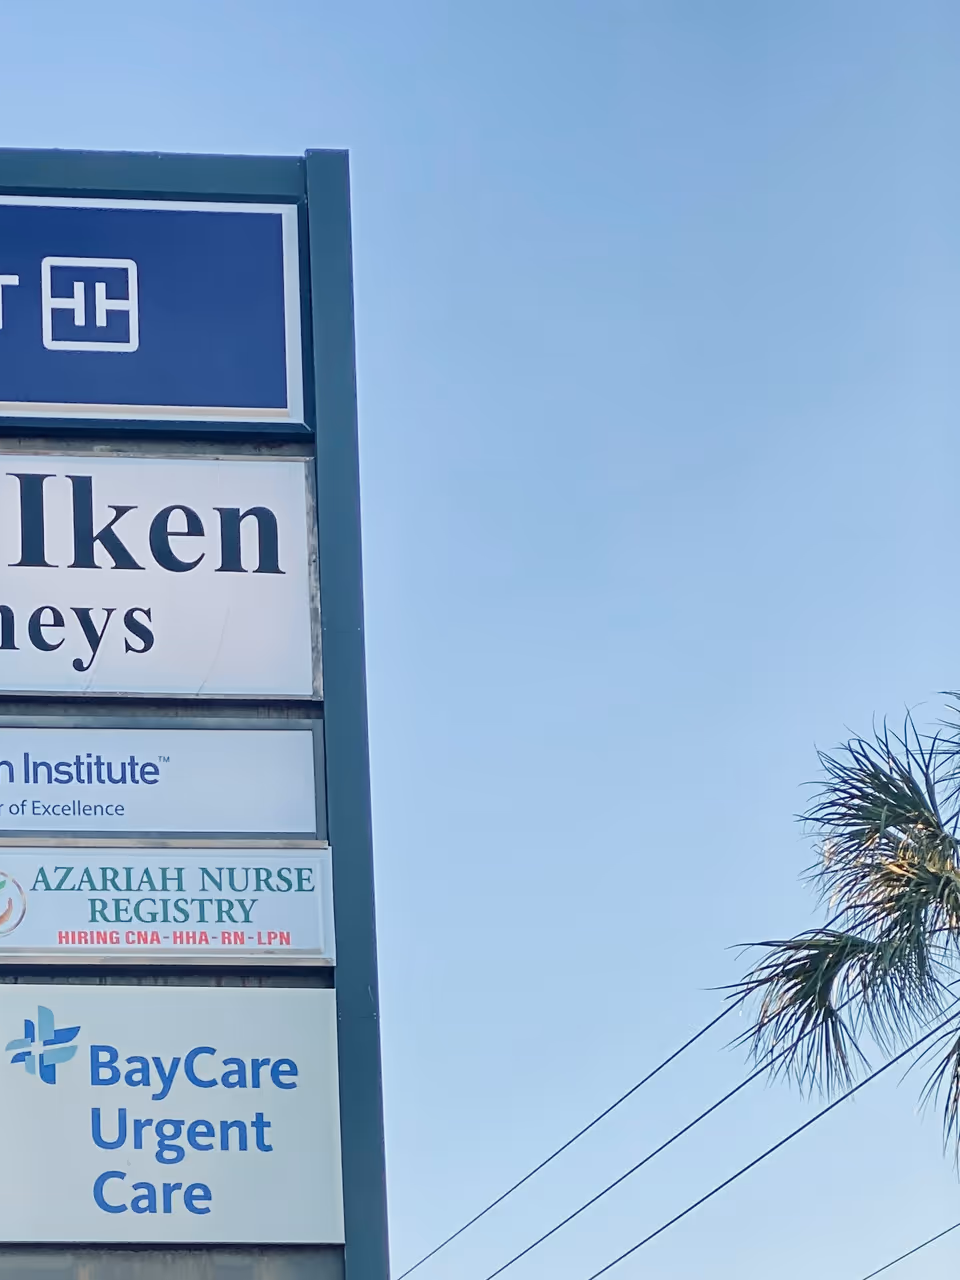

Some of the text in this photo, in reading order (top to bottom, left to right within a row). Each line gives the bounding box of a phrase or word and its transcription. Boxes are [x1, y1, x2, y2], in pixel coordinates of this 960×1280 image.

[7, 473, 286, 574] Iken
[9, 800, 27, 815] of
[32, 801, 124, 816] Excellence
[30, 867, 315, 892] AZARIAH NURSE
[88, 898, 258, 924] REGISTRY
[58, 931, 120, 945] HIRING
[91, 1045, 298, 1100] BayCare
[92, 1108, 273, 1164] Urgent
[93, 1171, 212, 1215] Care
